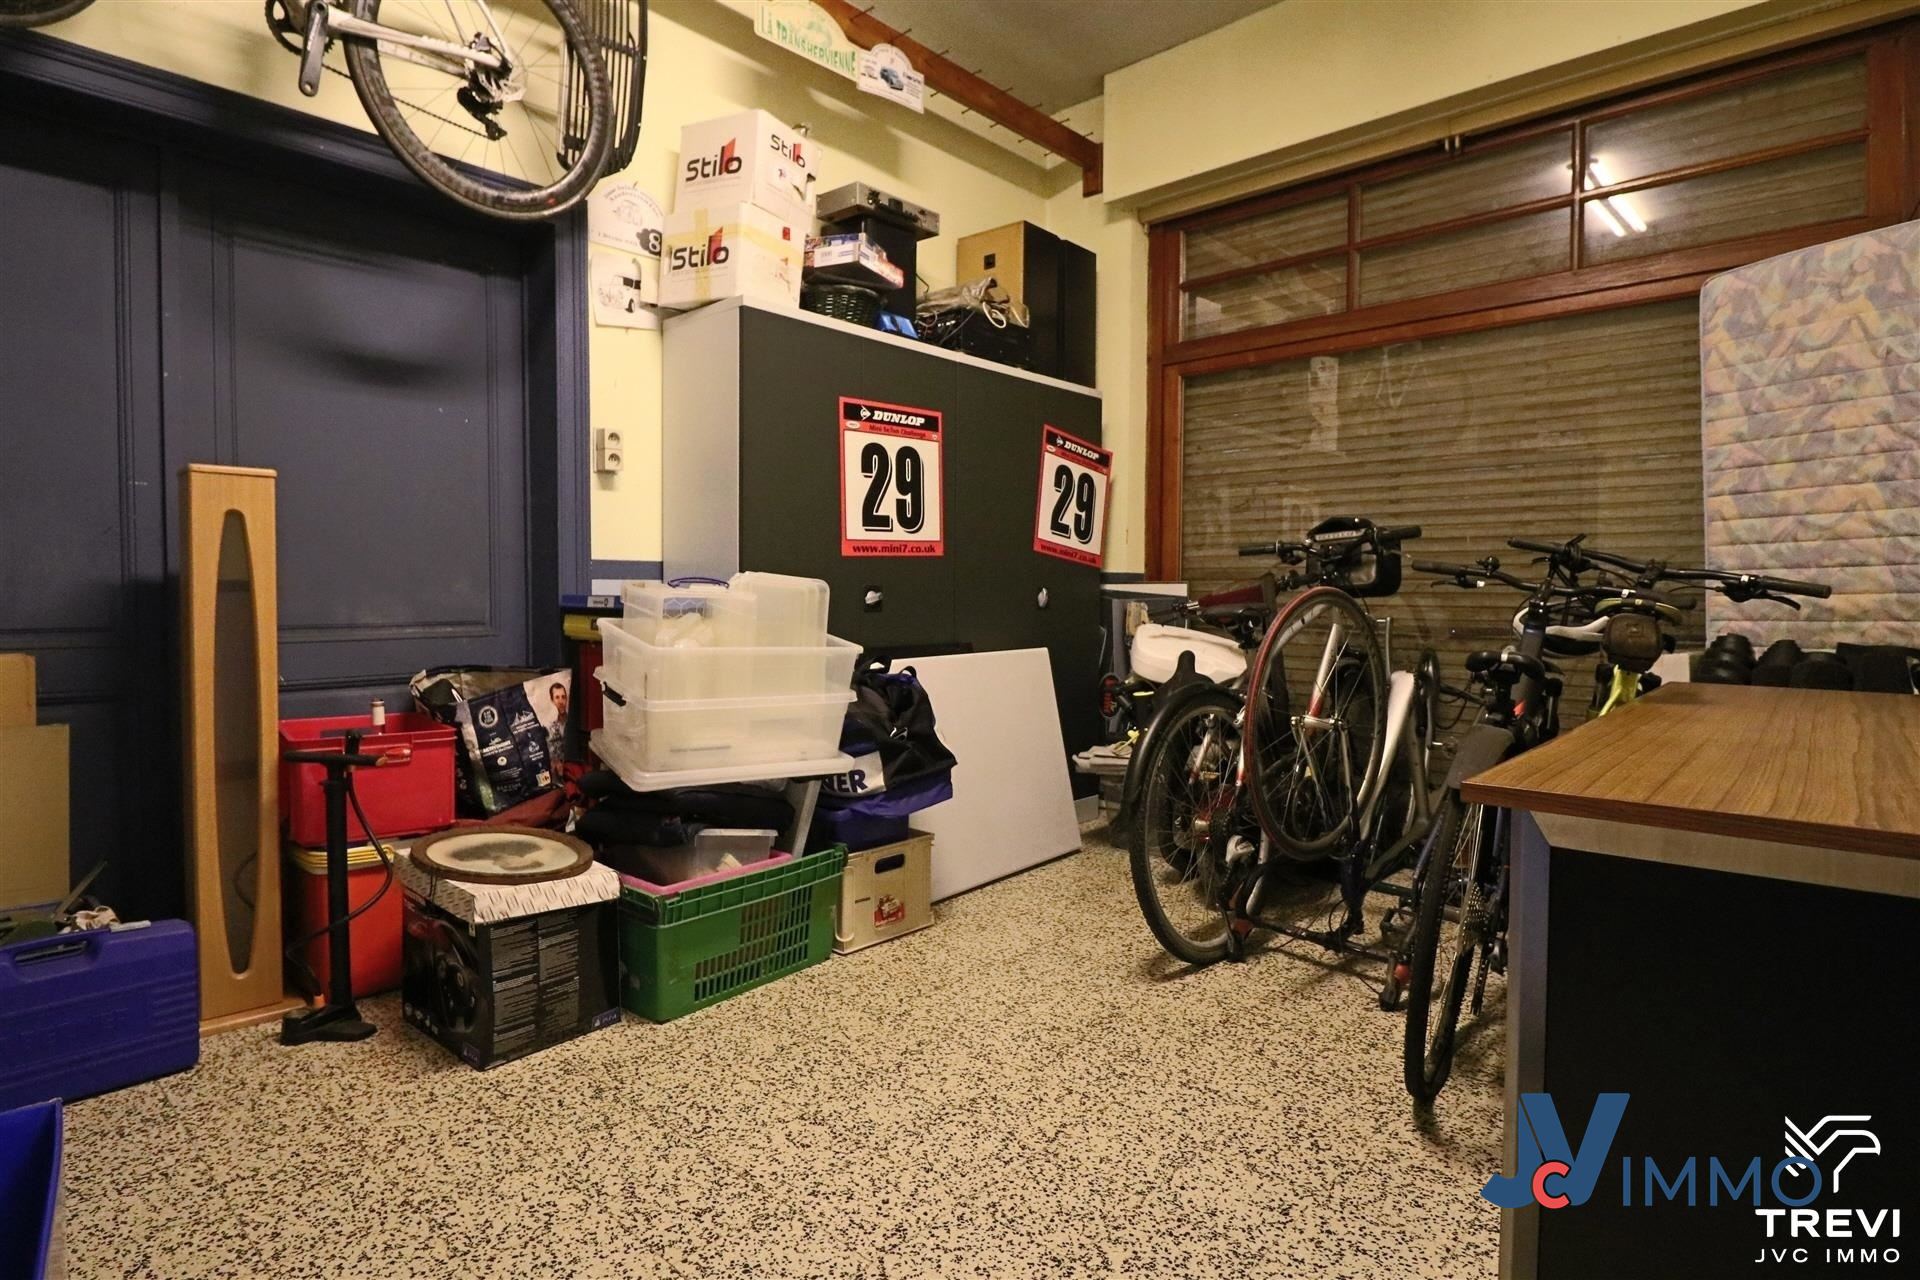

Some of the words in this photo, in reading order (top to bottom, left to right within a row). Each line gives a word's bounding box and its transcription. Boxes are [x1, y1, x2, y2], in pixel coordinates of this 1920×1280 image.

[685, 138, 743, 182] Stilo
[769, 134, 806, 168] Stilo
[671, 227, 730, 271] Stilo
[873, 410, 926, 426] DUNLOP
[1064, 440, 1100, 460] DUNLOP
[860, 441, 925, 534] 29
[1049, 464, 1097, 545] 29
[852, 543, 936, 554] www.mini7.co.uk
